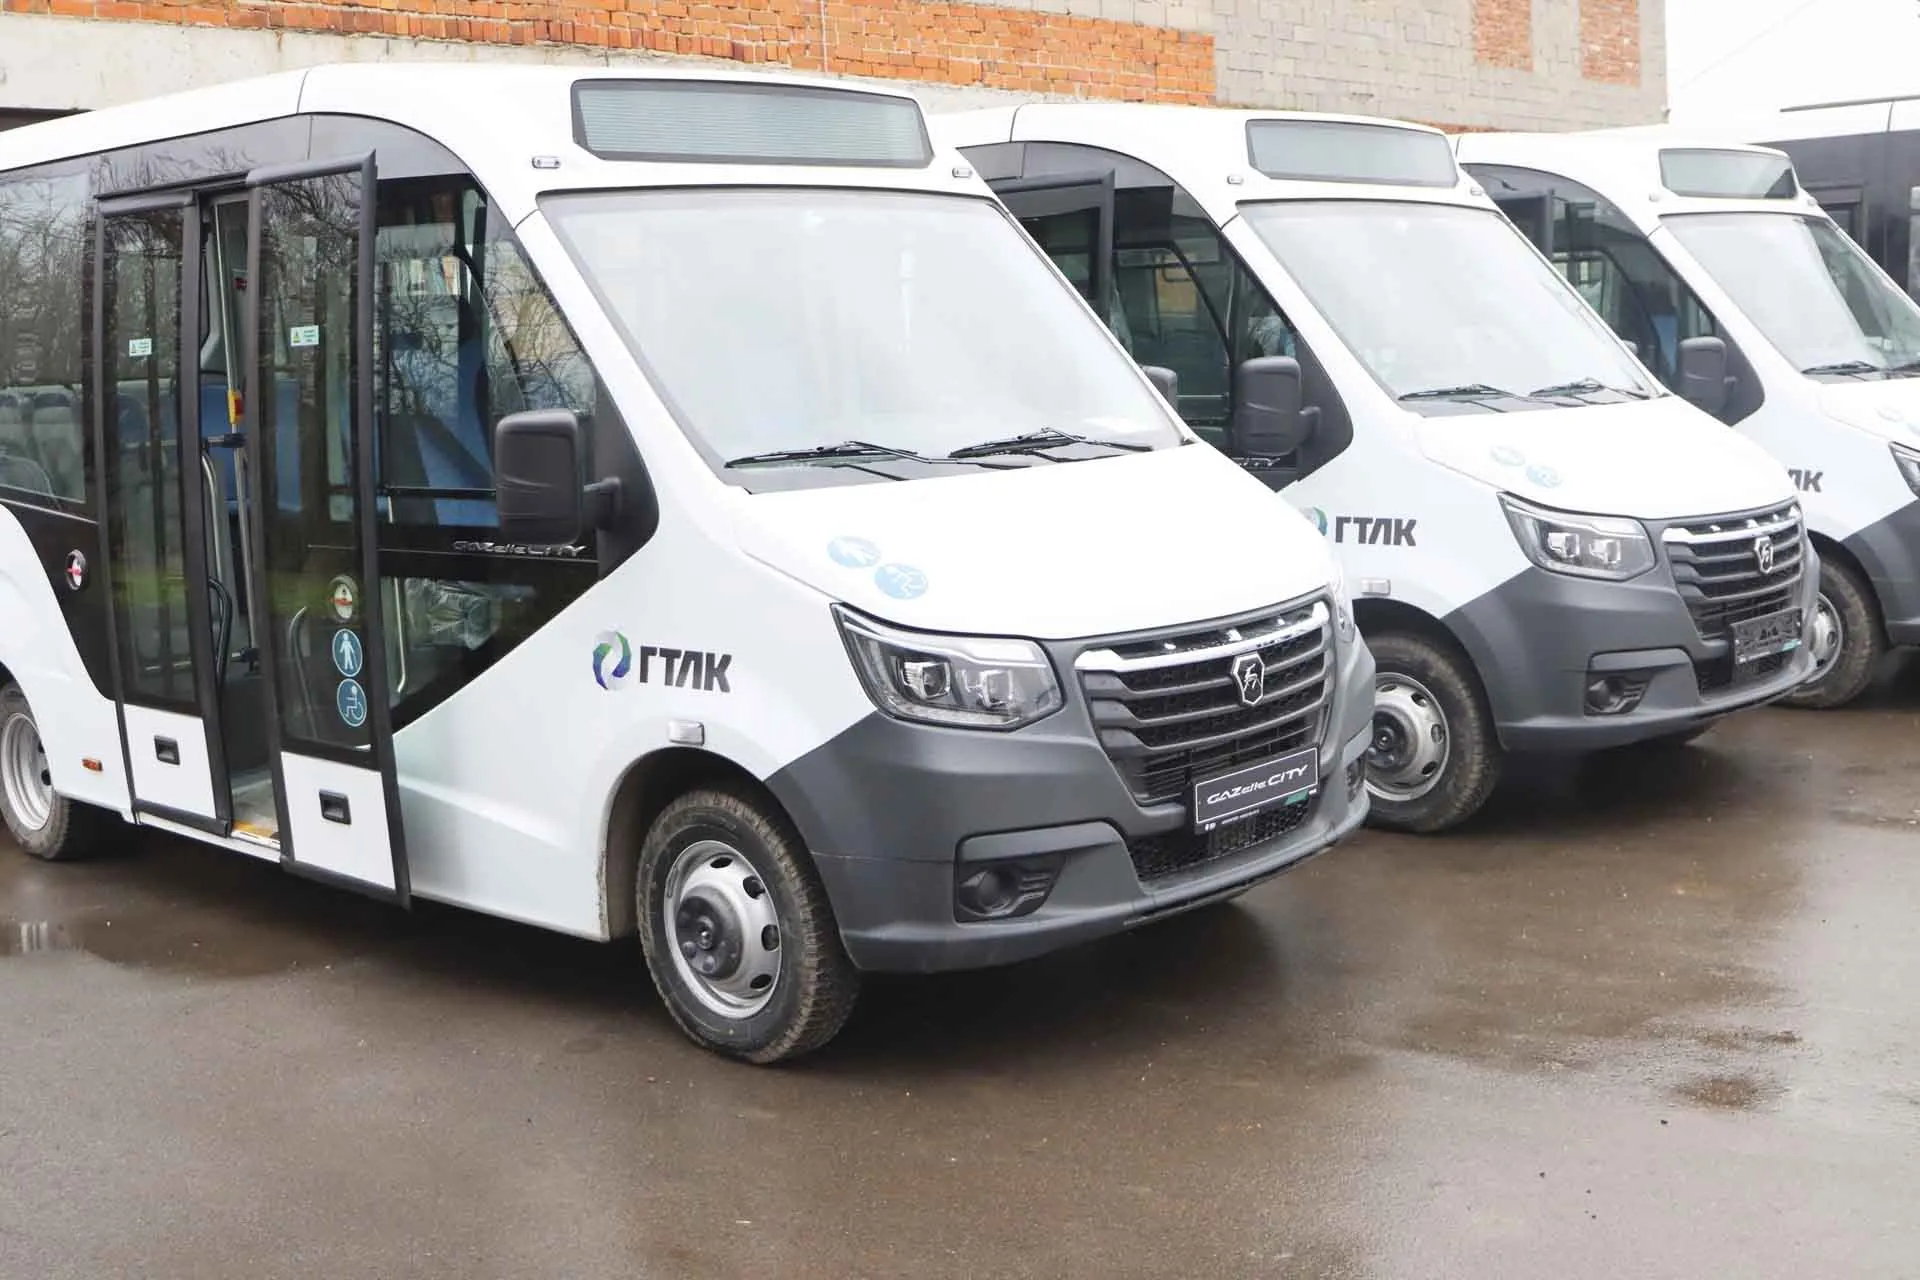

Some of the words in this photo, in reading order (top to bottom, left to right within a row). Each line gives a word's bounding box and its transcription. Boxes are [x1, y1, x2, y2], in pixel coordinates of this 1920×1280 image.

[1787, 468, 1824, 493] ЛК
[1335, 516, 1417, 547] ГТЛК
[639, 645, 732, 693] ГТЛК
